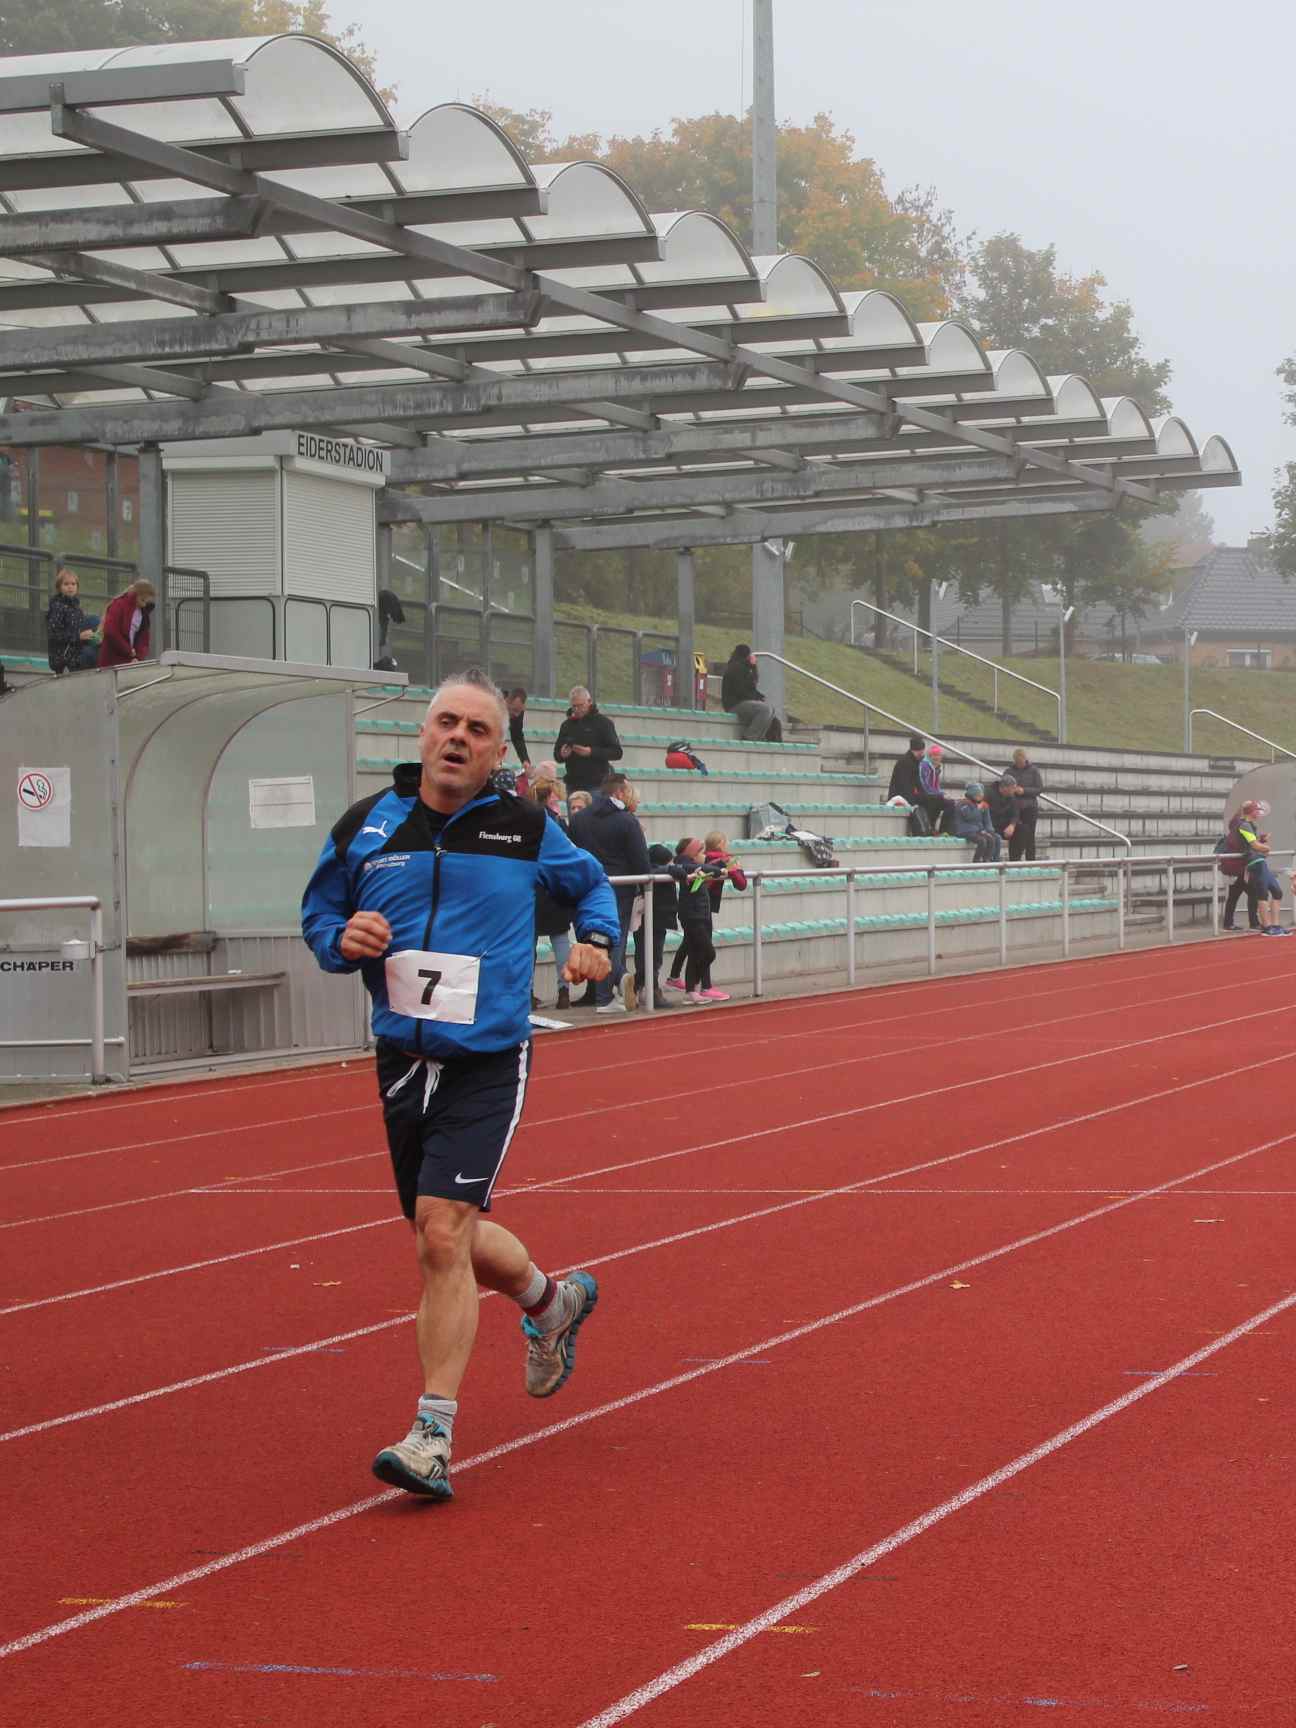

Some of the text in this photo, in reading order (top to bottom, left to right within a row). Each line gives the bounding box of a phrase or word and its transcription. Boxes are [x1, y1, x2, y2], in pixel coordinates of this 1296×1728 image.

[297, 433, 384, 473] EIDERSTADION
[479, 831, 512, 844] Flensburg
[417, 968, 442, 1006] 7
